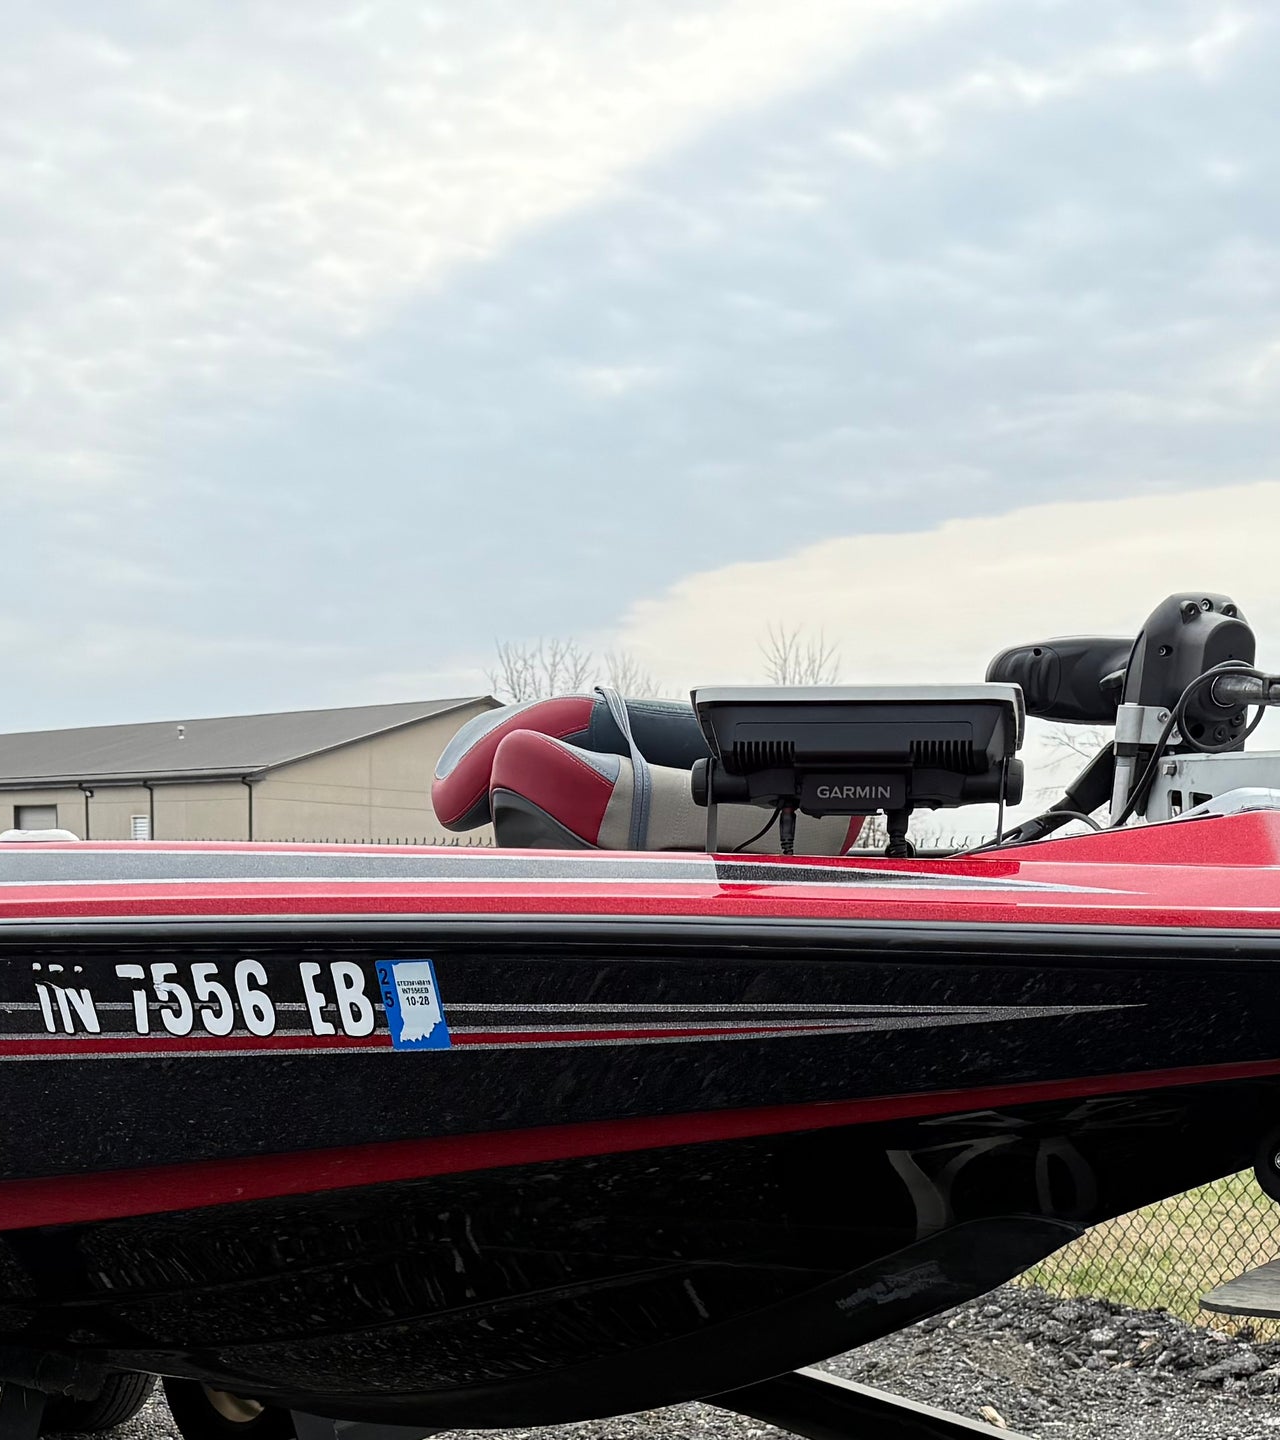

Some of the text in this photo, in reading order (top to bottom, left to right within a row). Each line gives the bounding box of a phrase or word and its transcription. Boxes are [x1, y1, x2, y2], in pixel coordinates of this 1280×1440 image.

[816, 785, 891, 799] GARMIN
[115, 959, 276, 1036] 7556
[299, 961, 375, 1037] EB
[406, 996, 430, 1006] 10-28
